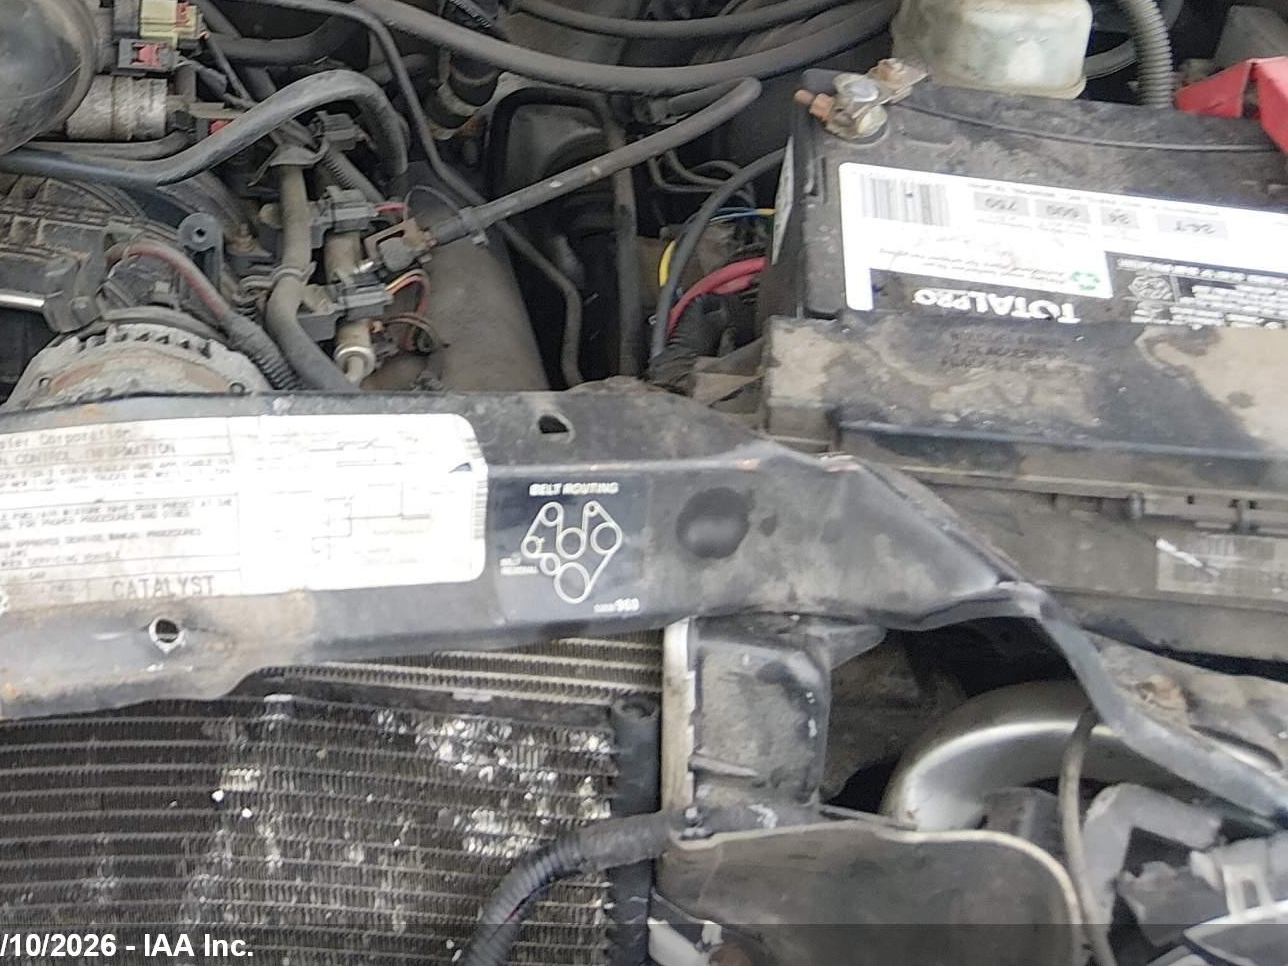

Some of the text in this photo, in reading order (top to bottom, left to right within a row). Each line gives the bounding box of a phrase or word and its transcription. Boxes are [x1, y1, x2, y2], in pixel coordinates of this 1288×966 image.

[40, 428, 131, 447] Corporation
[15, 448, 75, 466] CONTROL
[529, 483, 562, 496] BELT
[111, 574, 215, 600] CATALYST
